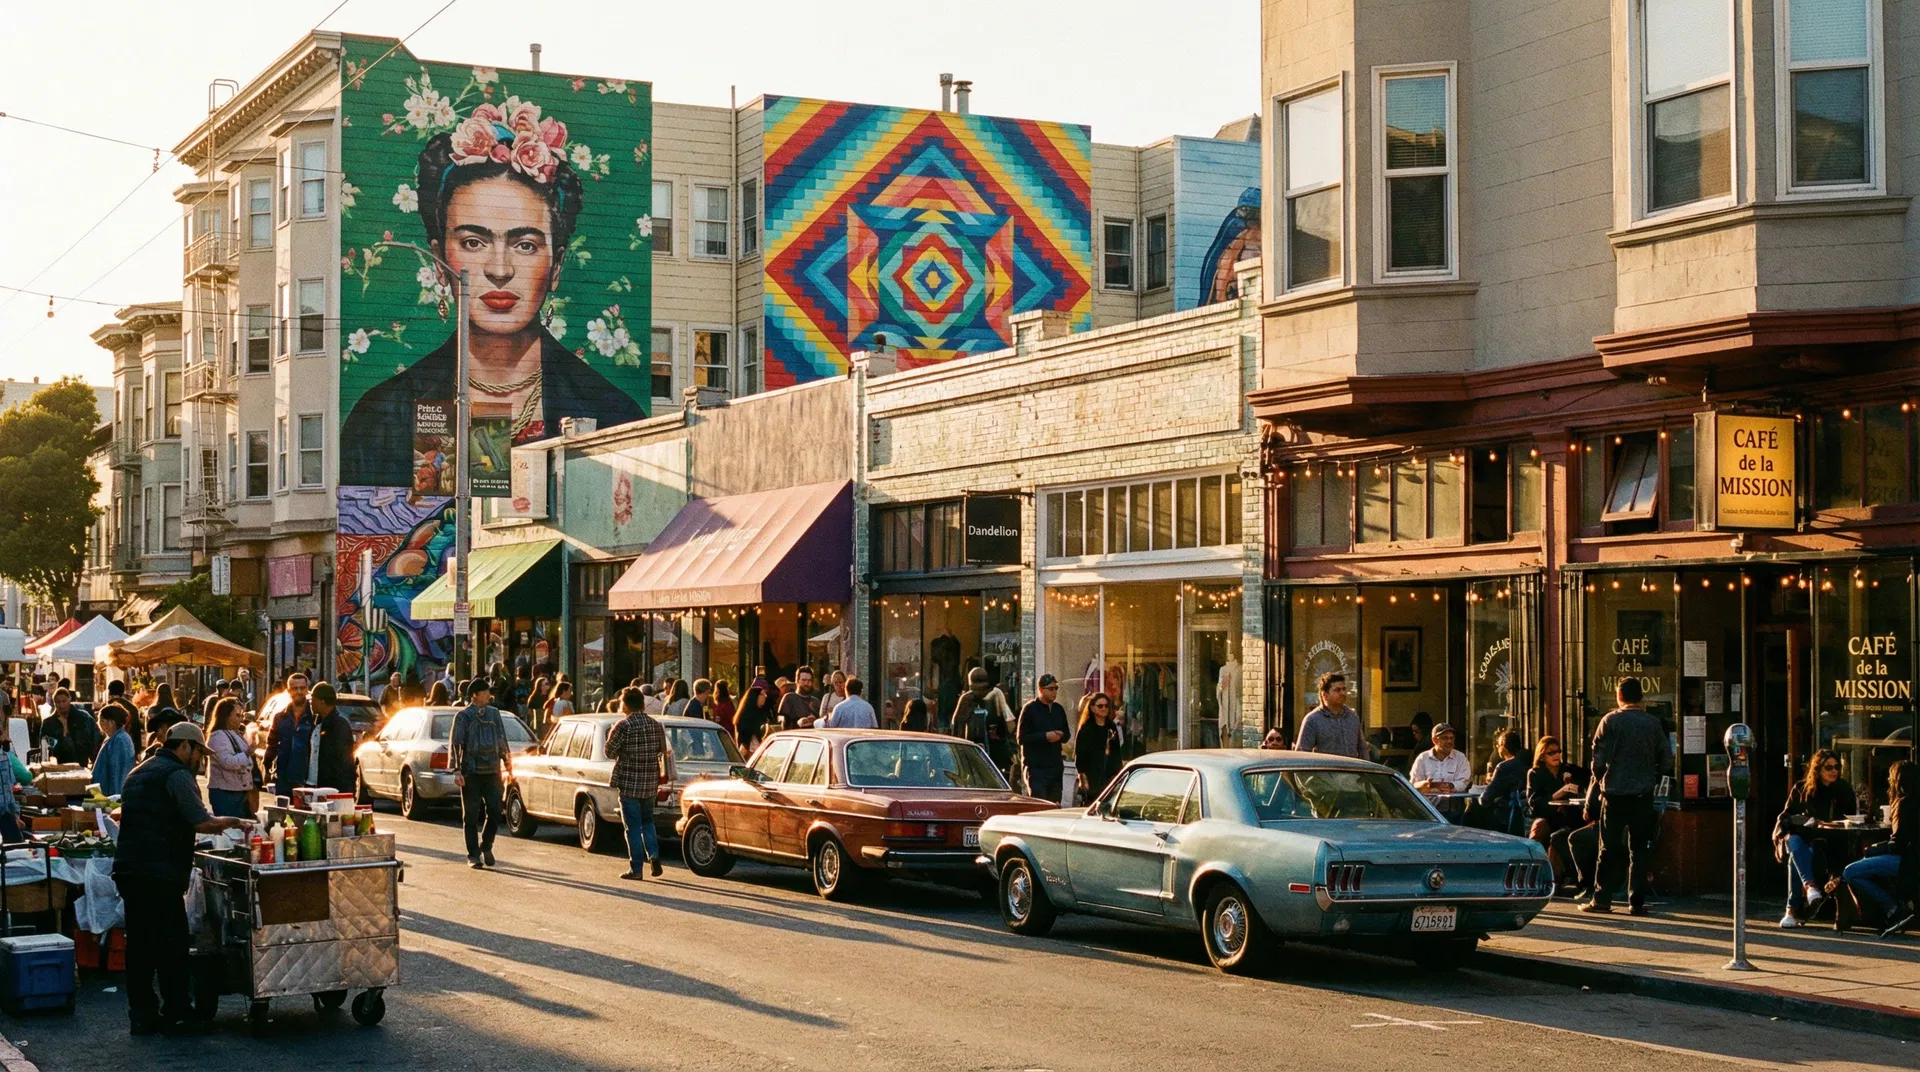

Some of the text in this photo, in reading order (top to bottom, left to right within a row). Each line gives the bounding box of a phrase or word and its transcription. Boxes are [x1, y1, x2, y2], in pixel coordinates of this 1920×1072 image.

[1734, 426, 1778, 449] CAFÉ
[1739, 454, 1774, 472] de la
[1721, 477, 1792, 497] MISSION
[968, 525, 1018, 537] Dandelion
[1612, 634, 1650, 655] CAFÉ
[1848, 632, 1897, 655] CAFÉ
[1618, 658, 1643, 672] de la
[1856, 660, 1888, 675] de la
[1835, 680, 1911, 699] MISSION
